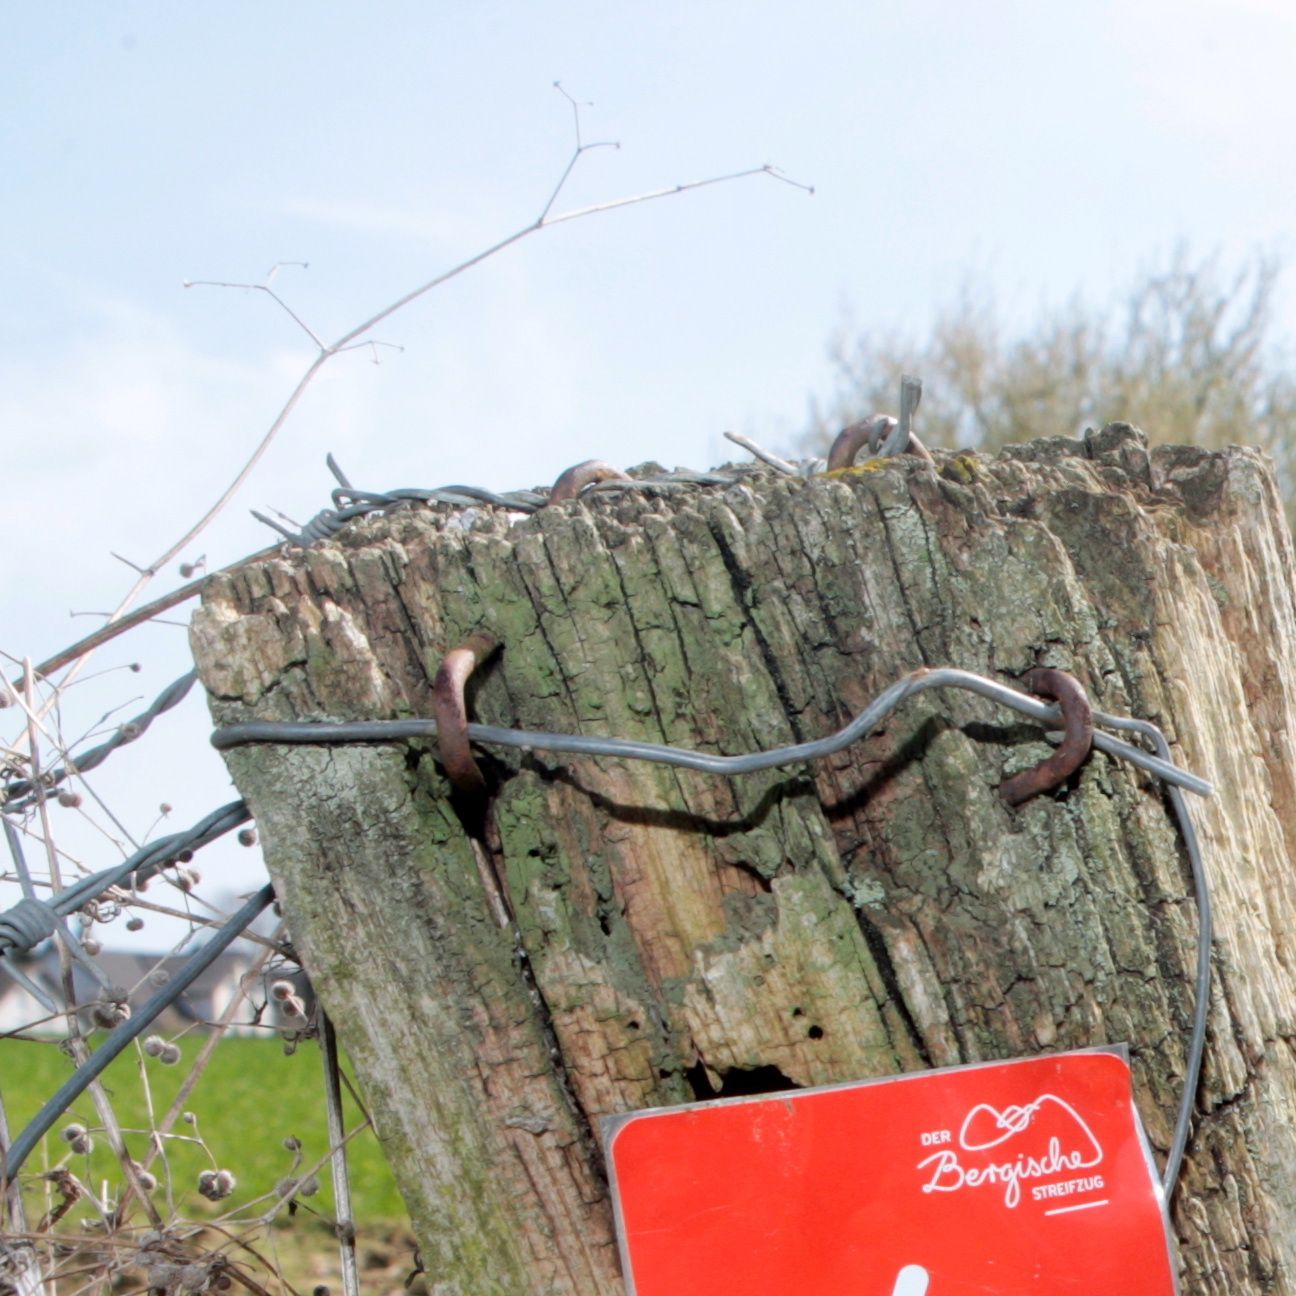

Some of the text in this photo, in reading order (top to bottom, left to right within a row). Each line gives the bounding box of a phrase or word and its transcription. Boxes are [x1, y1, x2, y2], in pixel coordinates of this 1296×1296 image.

[920, 1129, 952, 1147] DER
[917, 1136, 1088, 1209] Bergische
[1031, 1175, 1105, 1201] STREIFZUG
